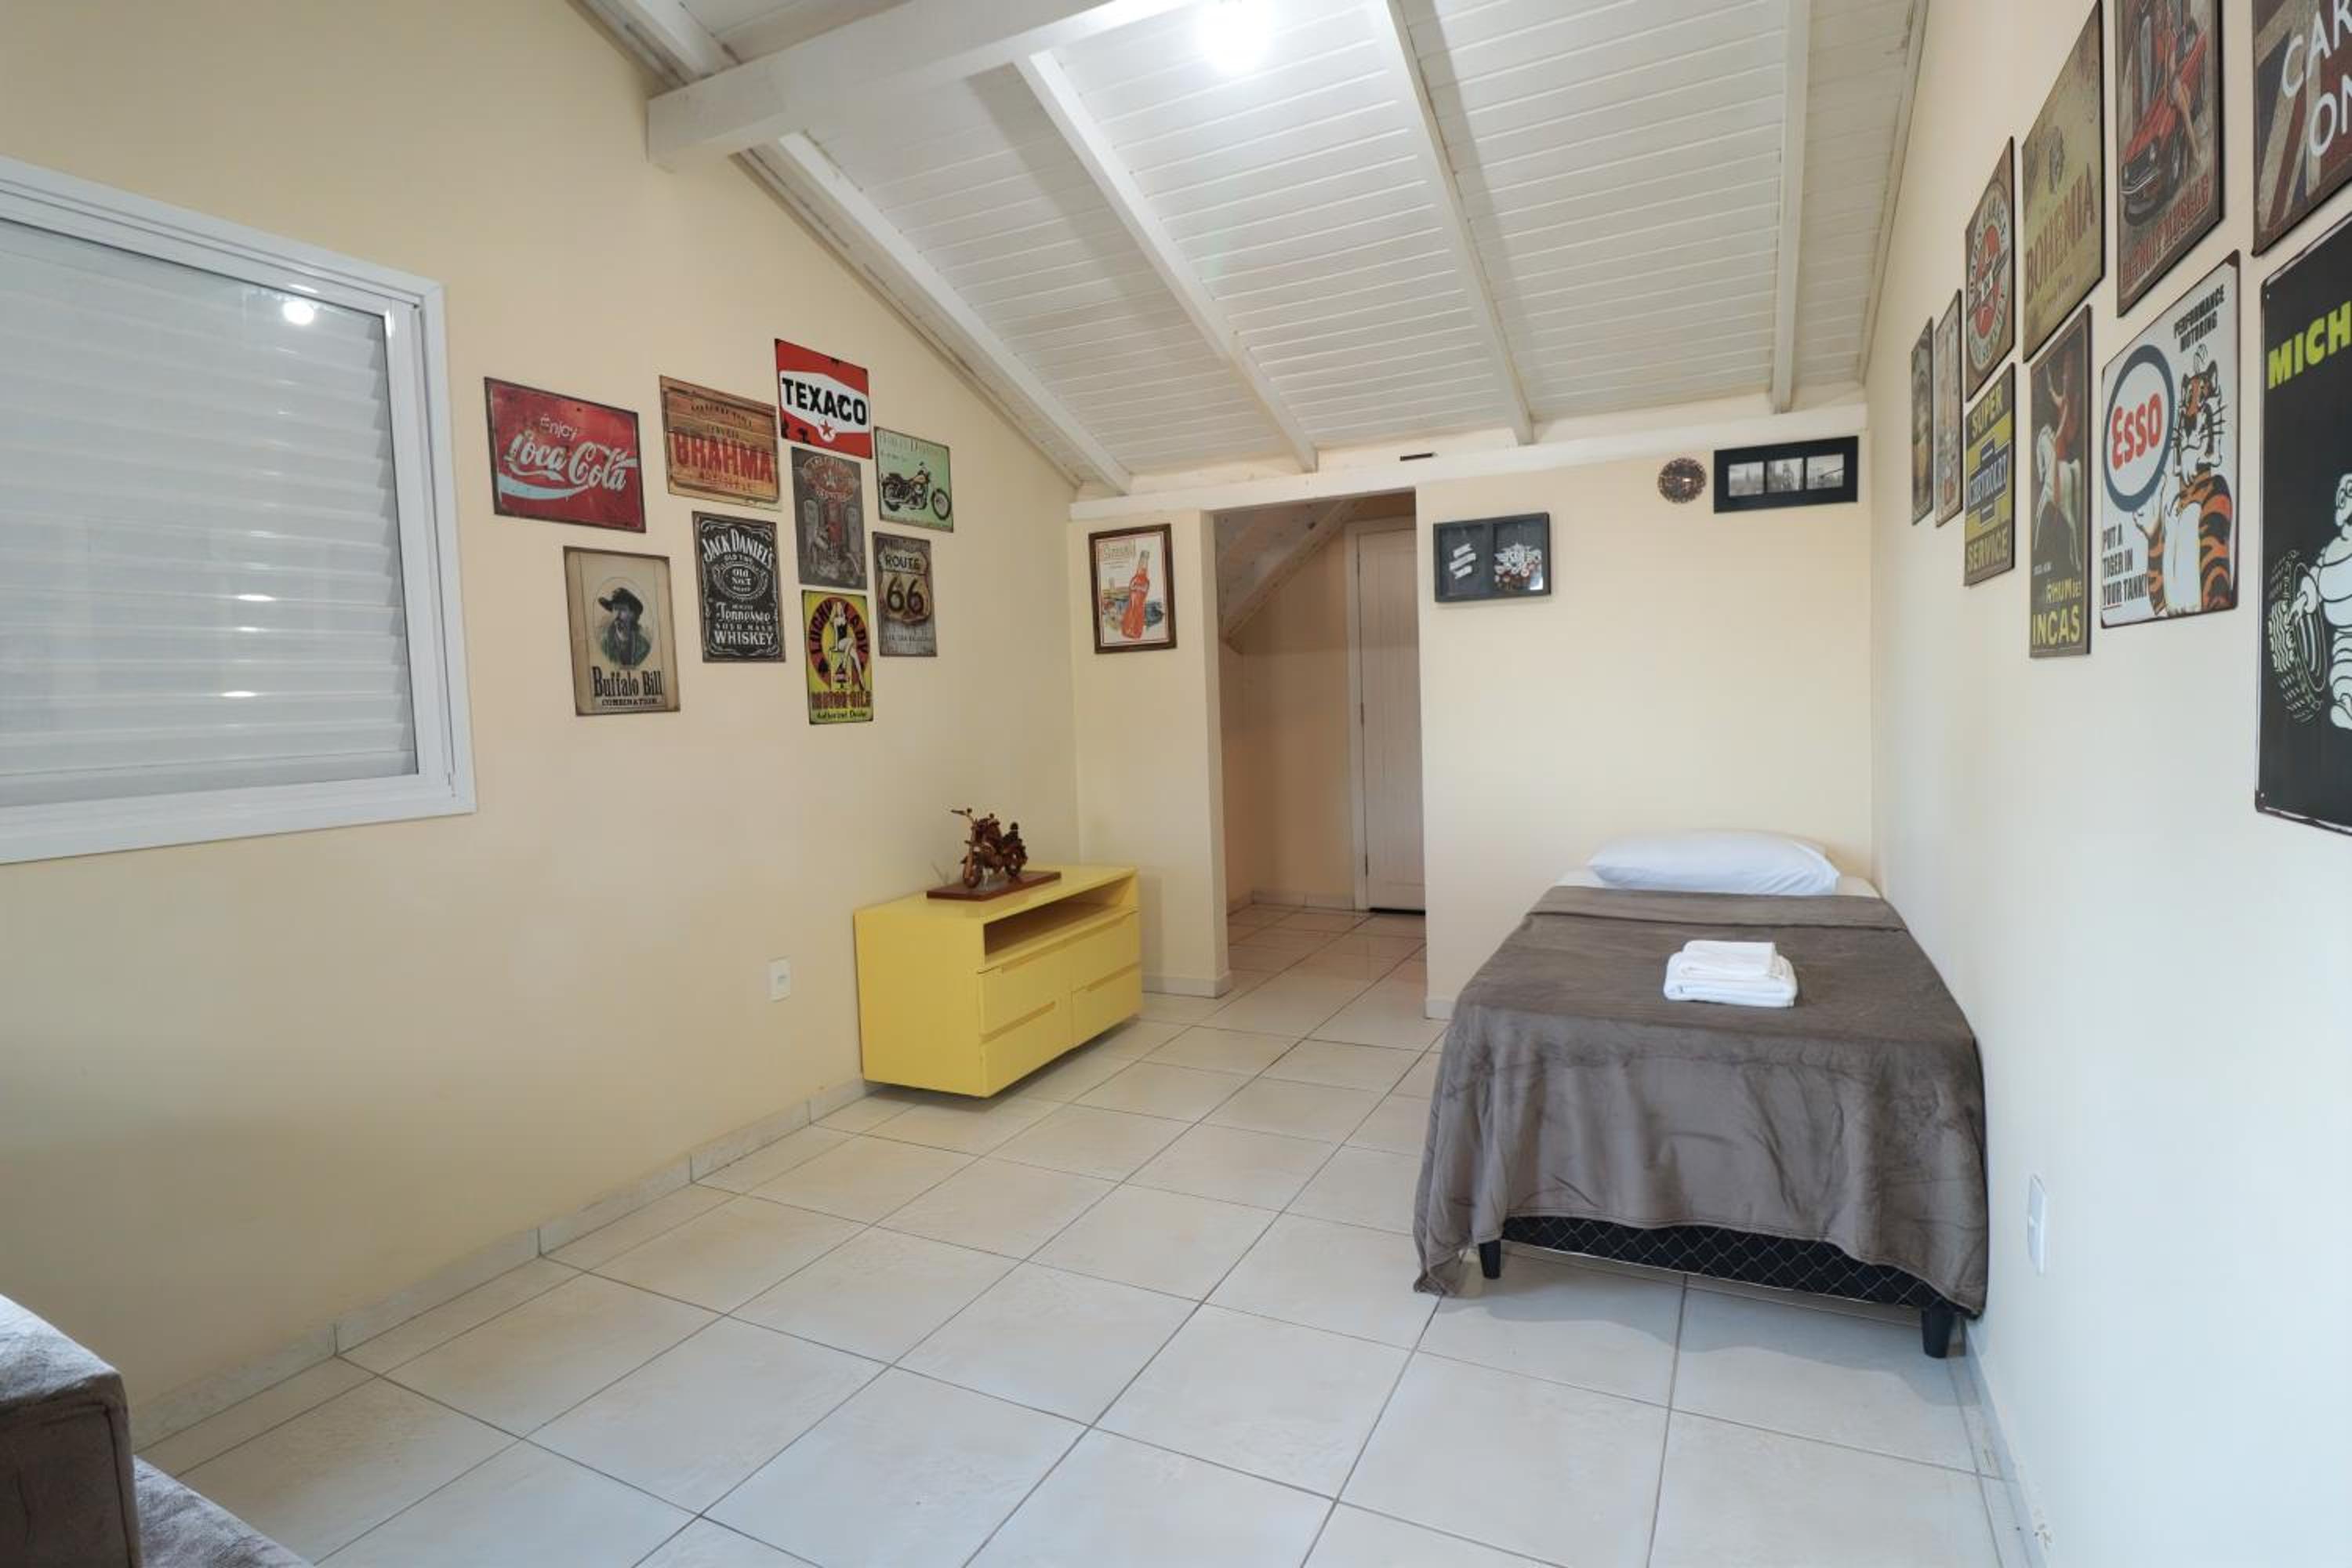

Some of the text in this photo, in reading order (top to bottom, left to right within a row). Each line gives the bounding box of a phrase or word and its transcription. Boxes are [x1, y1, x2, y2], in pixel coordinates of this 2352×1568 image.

[2027, 162, 2096, 304] BOHEMIA
[2268, 300, 2352, 390] MICH
[782, 377, 867, 426] TEXACO
[1970, 382, 2004, 440] SUPER
[540, 414, 578, 441] Enjoy
[673, 431, 774, 484] BRAHMA
[702, 528, 775, 570] JACK DANIEL'S
[885, 554, 921, 570] ROUTE
[1966, 526, 2009, 575] SERVICE
[886, 575, 925, 615] 66
[2045, 577, 2072, 603] RHUM
[714, 630, 775, 646] WHISKEY
[2032, 604, 2081, 645] INCAS
[592, 665, 663, 697] Buffalo Bill
